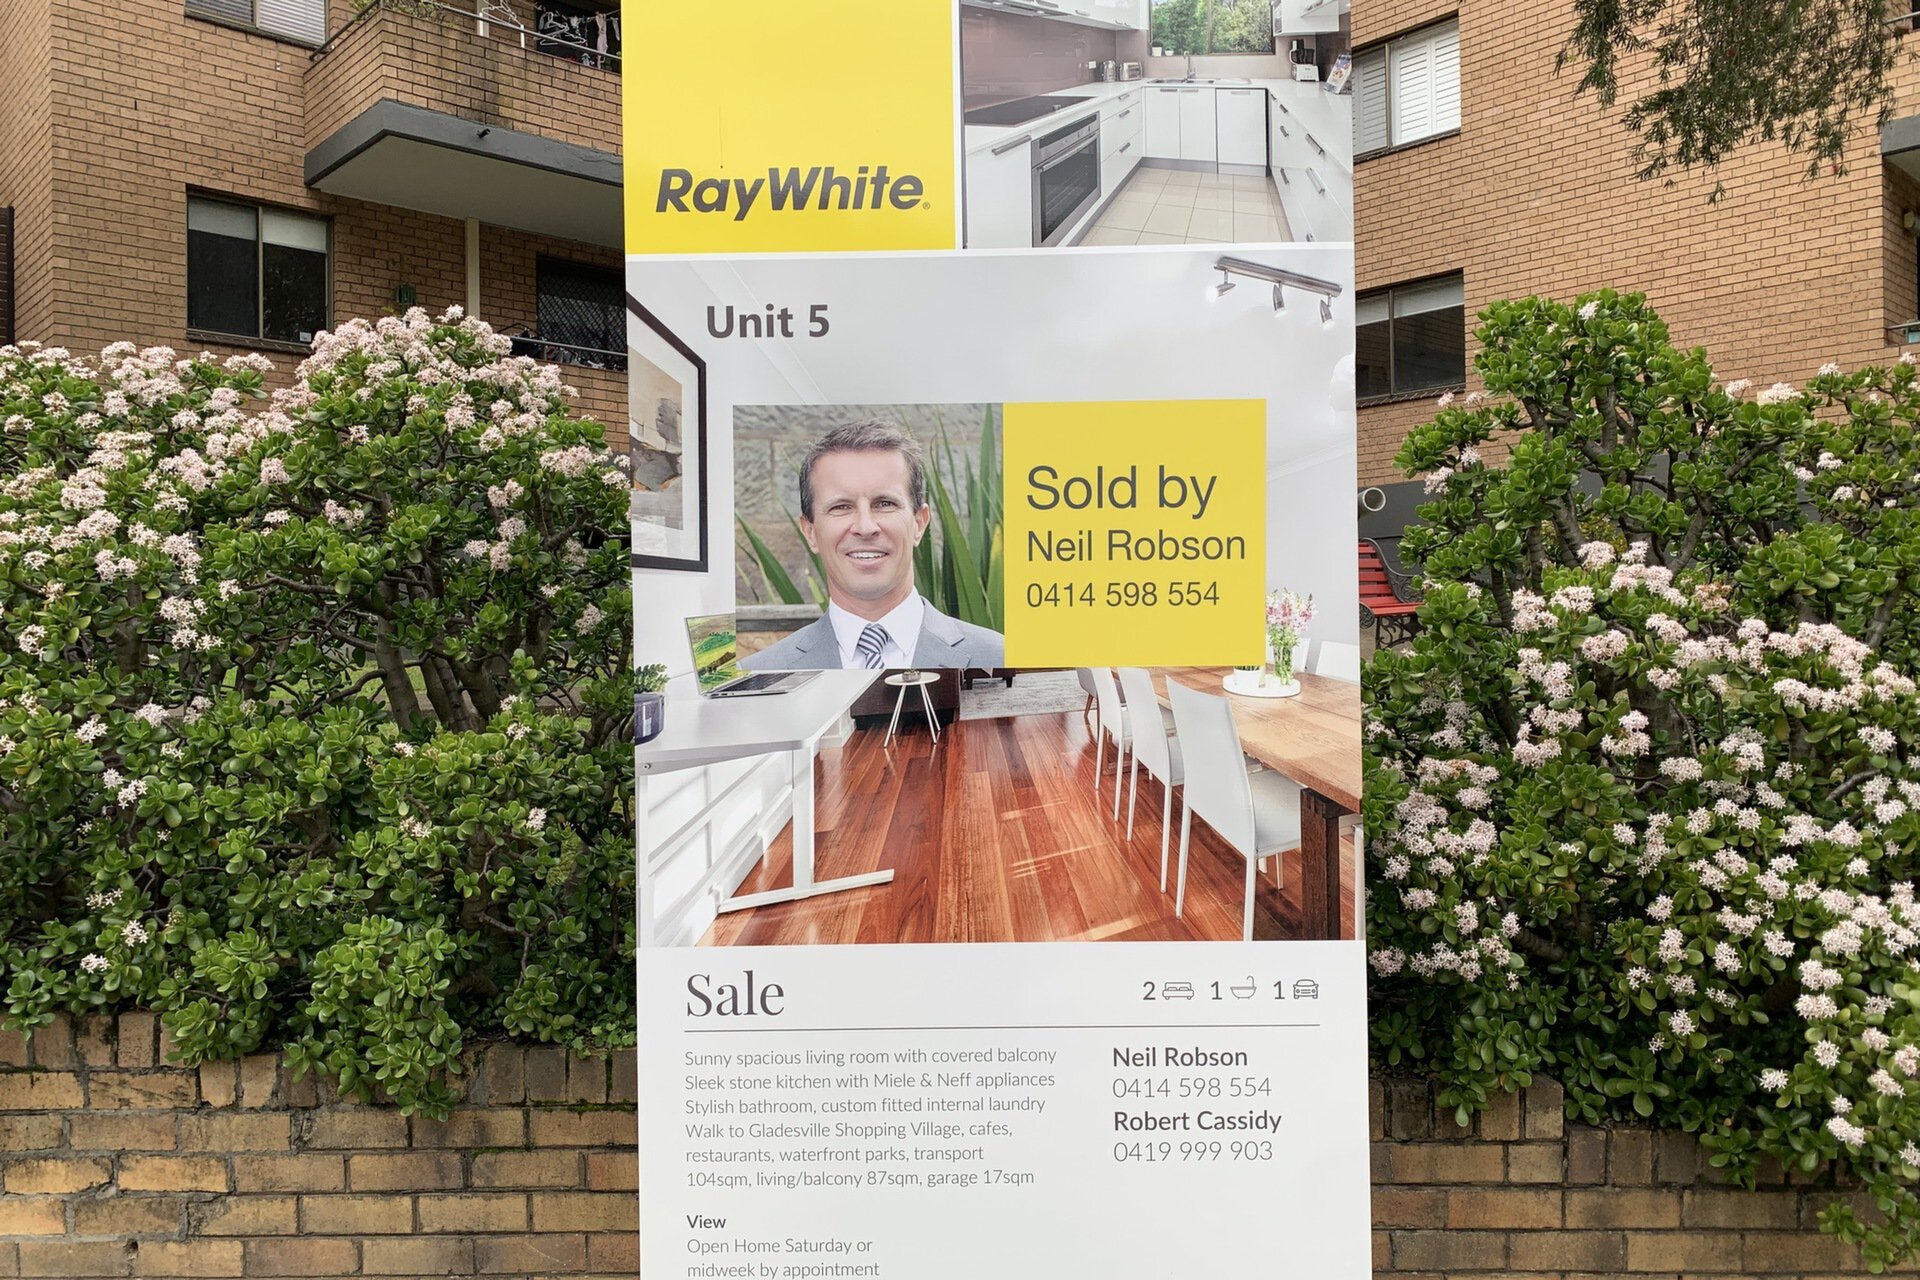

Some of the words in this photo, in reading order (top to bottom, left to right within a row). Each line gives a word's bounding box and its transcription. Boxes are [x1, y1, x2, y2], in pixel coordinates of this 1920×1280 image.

[706, 303, 794, 339] Unit
[808, 304, 830, 338] 5
[1027, 465, 1137, 511] Sold
[1158, 464, 1218, 520] by
[1028, 529, 1092, 562] Neil
[1108, 529, 1245, 561] Robson
[1026, 582, 1096, 608] 0414
[1105, 581, 1158, 607] 598
[1167, 581, 1220, 607] 554
[687, 969, 785, 1017] Sale
[1142, 981, 1156, 1001] 2
[1210, 980, 1223, 1001] 1
[1273, 980, 1286, 1000] 1
[685, 1051, 732, 1068] Sunny
[736, 1050, 802, 1068] spacious
[806, 1049, 846, 1068] living
[849, 1052, 890, 1064] room
[893, 1048, 927, 1064] with
[931, 1047, 993, 1063] covered
[997, 1047, 1057, 1065] balcony
[1113, 1046, 1157, 1068] Neil
[1164, 1046, 1248, 1067] Robson
[685, 1075, 725, 1090] Sleek
[729, 1076, 772, 1090] stone
[776, 1074, 831, 1089] kitchen
[835, 1073, 869, 1088] with
[874, 1073, 916, 1088] Miele
[920, 1072, 933, 1088] &
[937, 1072, 972, 1087] Neff
[975, 1071, 1056, 1090] appliances
[1112, 1078, 1171, 1099] 0414
[1179, 1077, 1222, 1098] 598
[1230, 1077, 1272, 1098] 554
[685, 1099, 734, 1117] Stylish
[739, 1099, 817, 1114] bathroom,
[821, 1099, 877, 1113] custom
[881, 1097, 922, 1112] fitted
[927, 1096, 984, 1112] internal
[989, 1096, 1046, 1114] laundry
[685, 1123, 725, 1138] Walk
[729, 1125, 745, 1138] to
[749, 1122, 831, 1138] Gladesville
[835, 1121, 907, 1140] Shopping
[910, 1121, 965, 1139] Village,
[969, 1120, 1013, 1137] cafes,
[1114, 1110, 1191, 1132] Robert
[1196, 1109, 1282, 1134] Cassidy
[686, 1148, 775, 1163] restaurants,
[779, 1146, 861, 1162] waterfront
[865, 1146, 909, 1164] parks,
[914, 1146, 984, 1163] transport
[1113, 1141, 1172, 1162] 0419
[1179, 1141, 1222, 1161] 999
[1230, 1140, 1273, 1161] 903
[687, 1172, 752, 1189] 104sqm,
[756, 1171, 863, 1189] living/balcony
[867, 1170, 923, 1188] 87sqm,
[927, 1173, 978, 1188] garage
[983, 1169, 1034, 1187] 17sqm
[686, 1214, 727, 1229] View
[687, 1238, 729, 1256] Open
[734, 1238, 781, 1253] Home
[785, 1237, 853, 1256] Saturday
[856, 1241, 873, 1252] or
[687, 1262, 756, 1278] midweek
[760, 1262, 779, 1280] by
[782, 1262, 880, 1280] appointment
